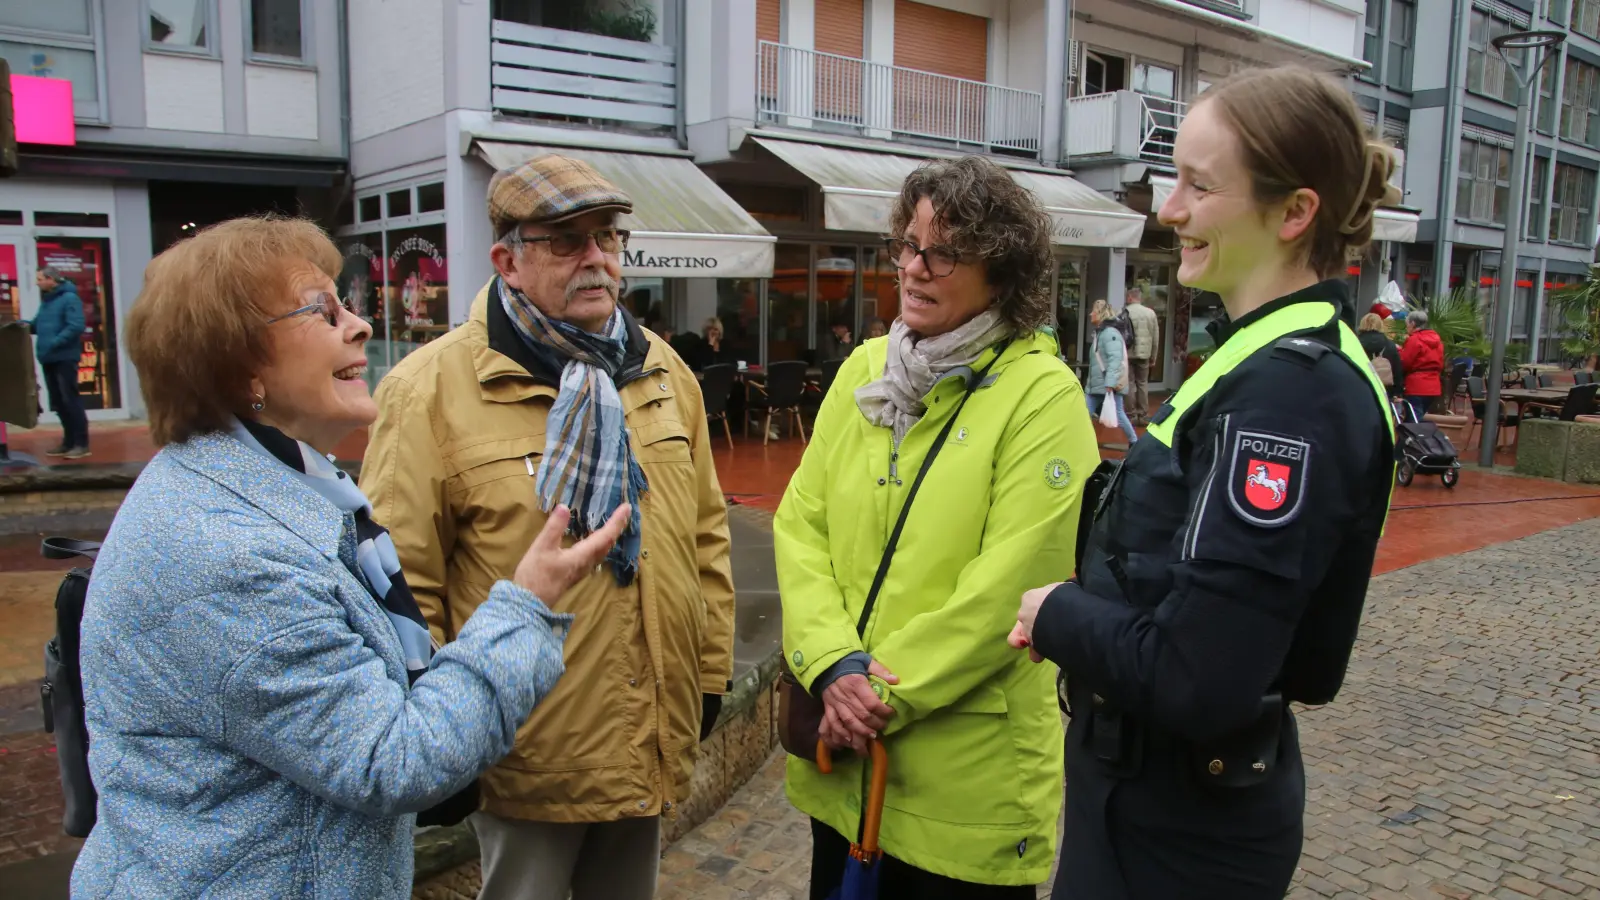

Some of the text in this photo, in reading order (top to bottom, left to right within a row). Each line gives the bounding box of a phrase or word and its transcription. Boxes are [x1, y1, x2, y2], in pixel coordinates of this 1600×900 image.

[1050, 217, 1084, 238] liano
[623, 250, 718, 269] MARTINO
[1241, 439, 1303, 461] POLIZEI
